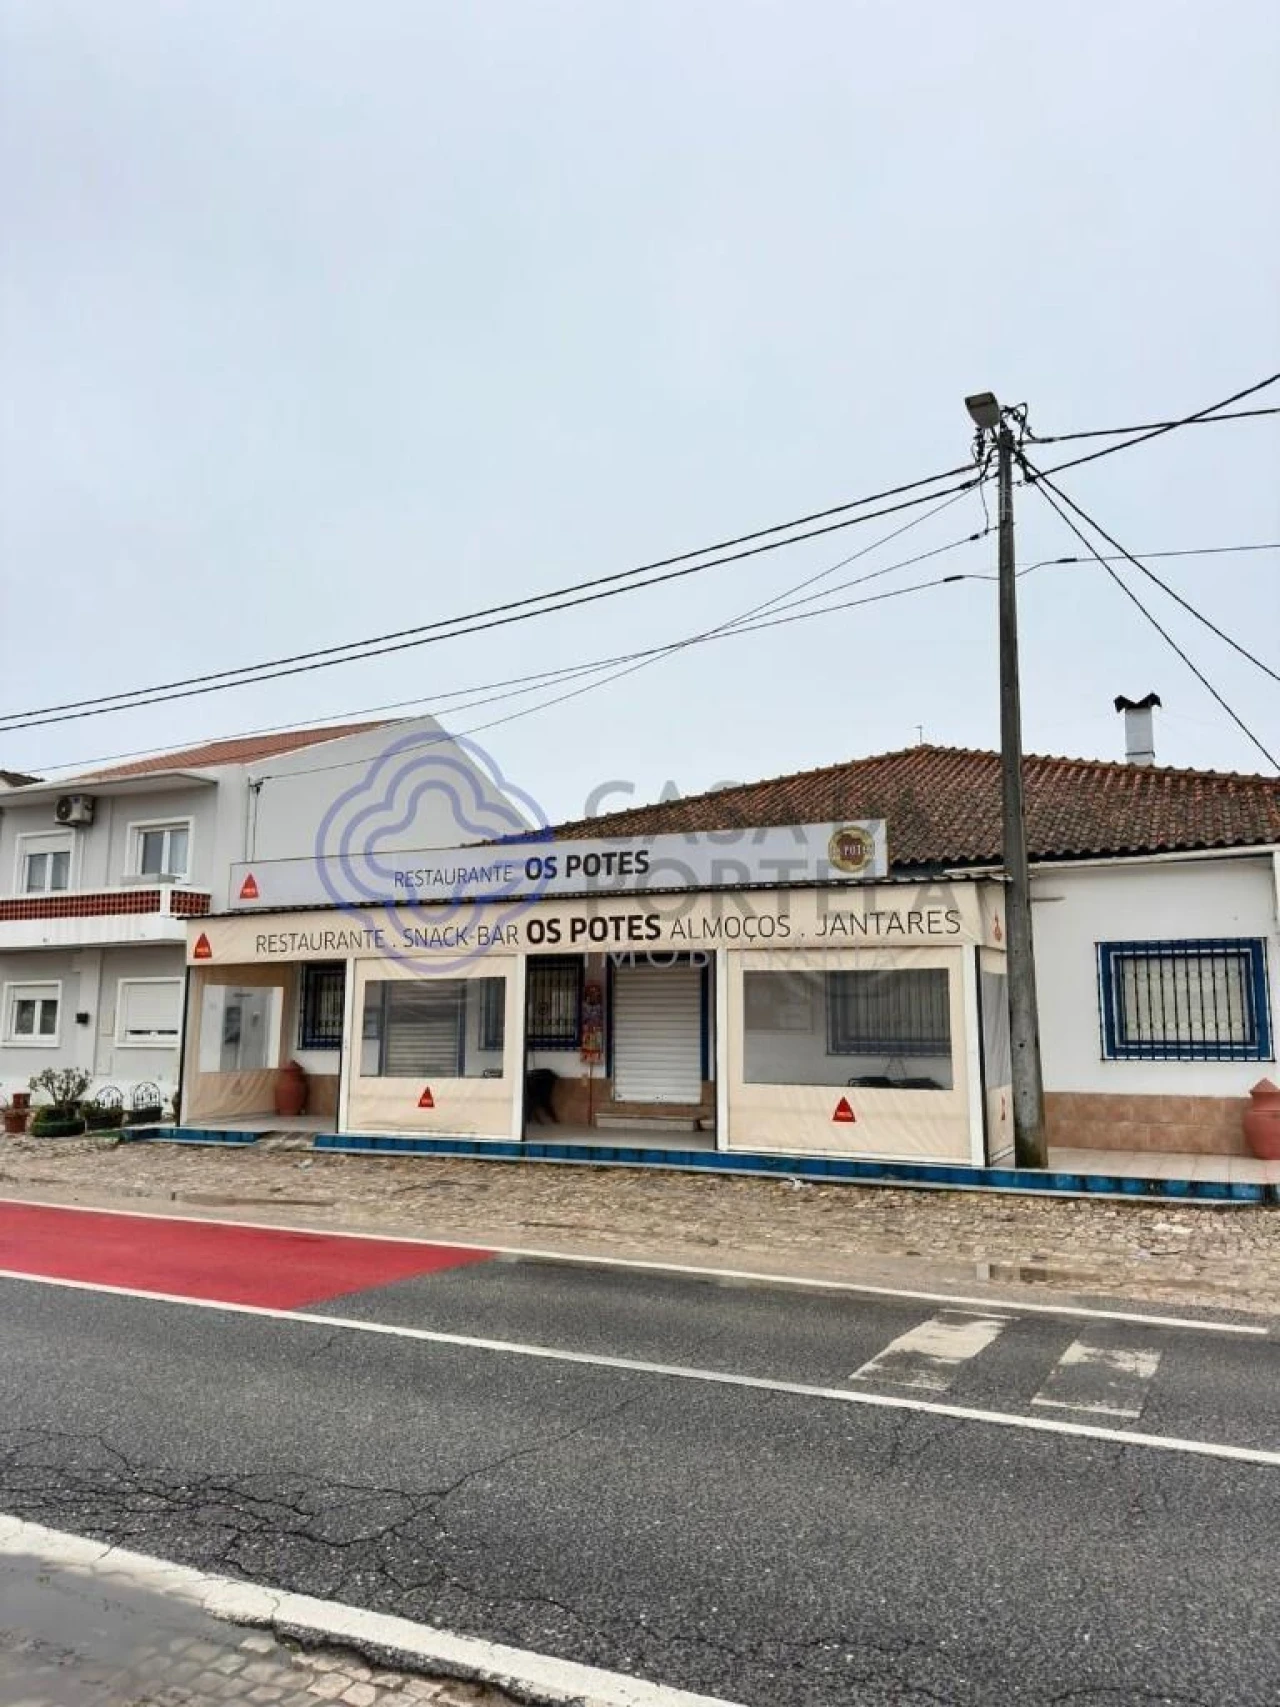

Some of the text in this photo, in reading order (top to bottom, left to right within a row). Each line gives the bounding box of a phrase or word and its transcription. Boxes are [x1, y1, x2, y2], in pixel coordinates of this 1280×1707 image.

[394, 850, 649, 888] RESTAURANTE OS POTES
[256, 929, 384, 953] RESTAURANTE
[403, 924, 519, 949] SNACK-BAR
[526, 918, 561, 944] OS
[570, 914, 661, 943] POTES
[670, 914, 791, 941] ALMOÇOS
[814, 909, 962, 936] JANTARES
